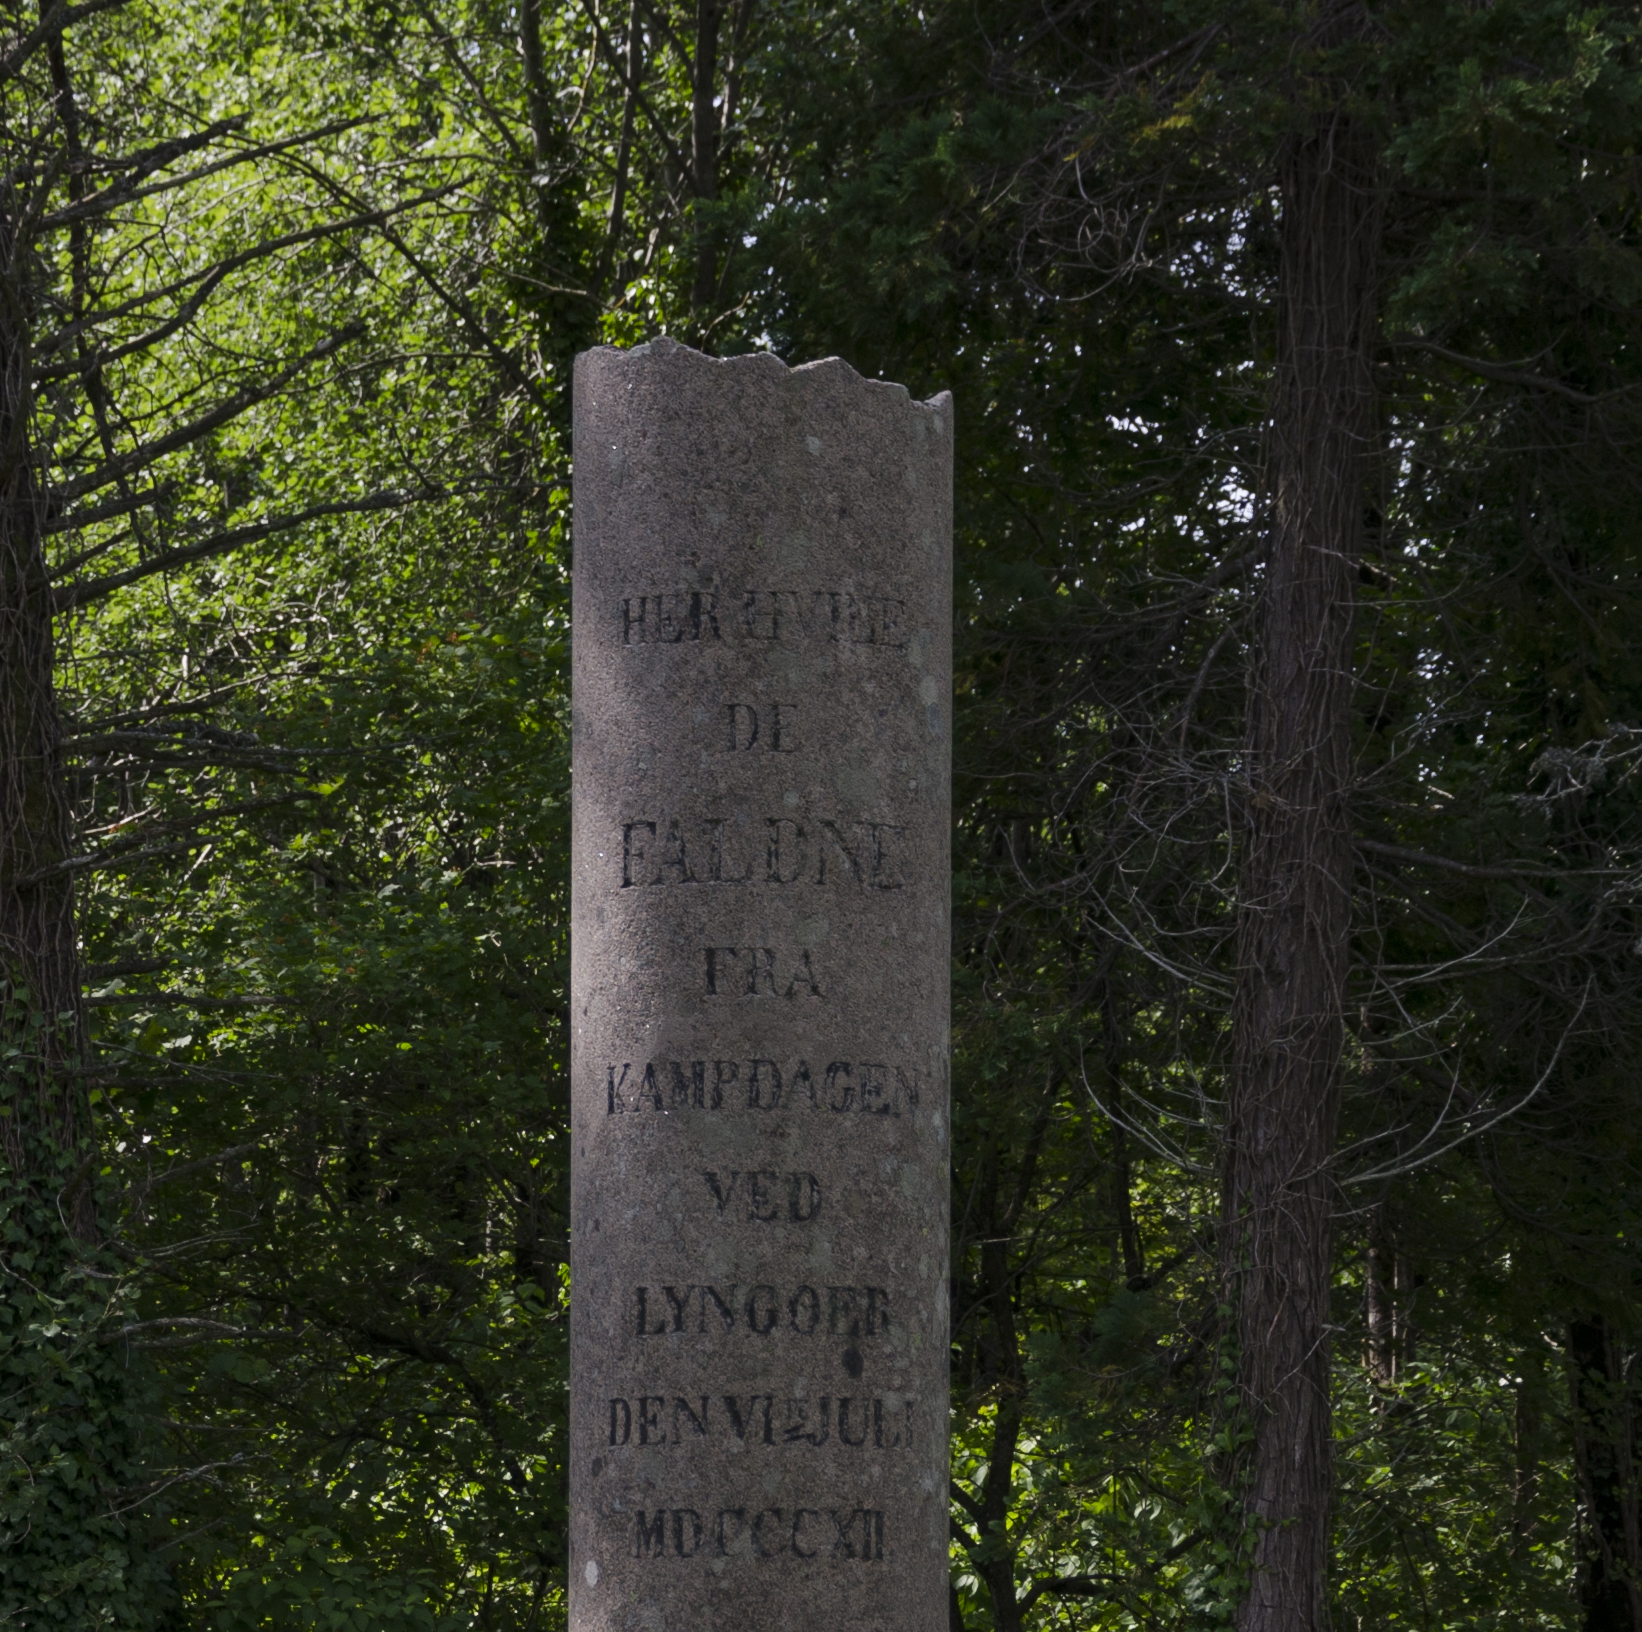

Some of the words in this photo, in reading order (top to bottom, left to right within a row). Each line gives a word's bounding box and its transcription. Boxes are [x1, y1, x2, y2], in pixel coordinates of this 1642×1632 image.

[621, 591, 725, 646] HER
[727, 703, 798, 753] DE
[620, 817, 909, 889] FALDNE
[702, 946, 828, 998] FRA
[606, 1058, 921, 1117] KAMPDAGEN
[701, 1170, 822, 1223] VED
[607, 1396, 710, 1447] DEN
[807, 1395, 916, 1450] JULI
[633, 1506, 886, 1561] MDCCCXII
